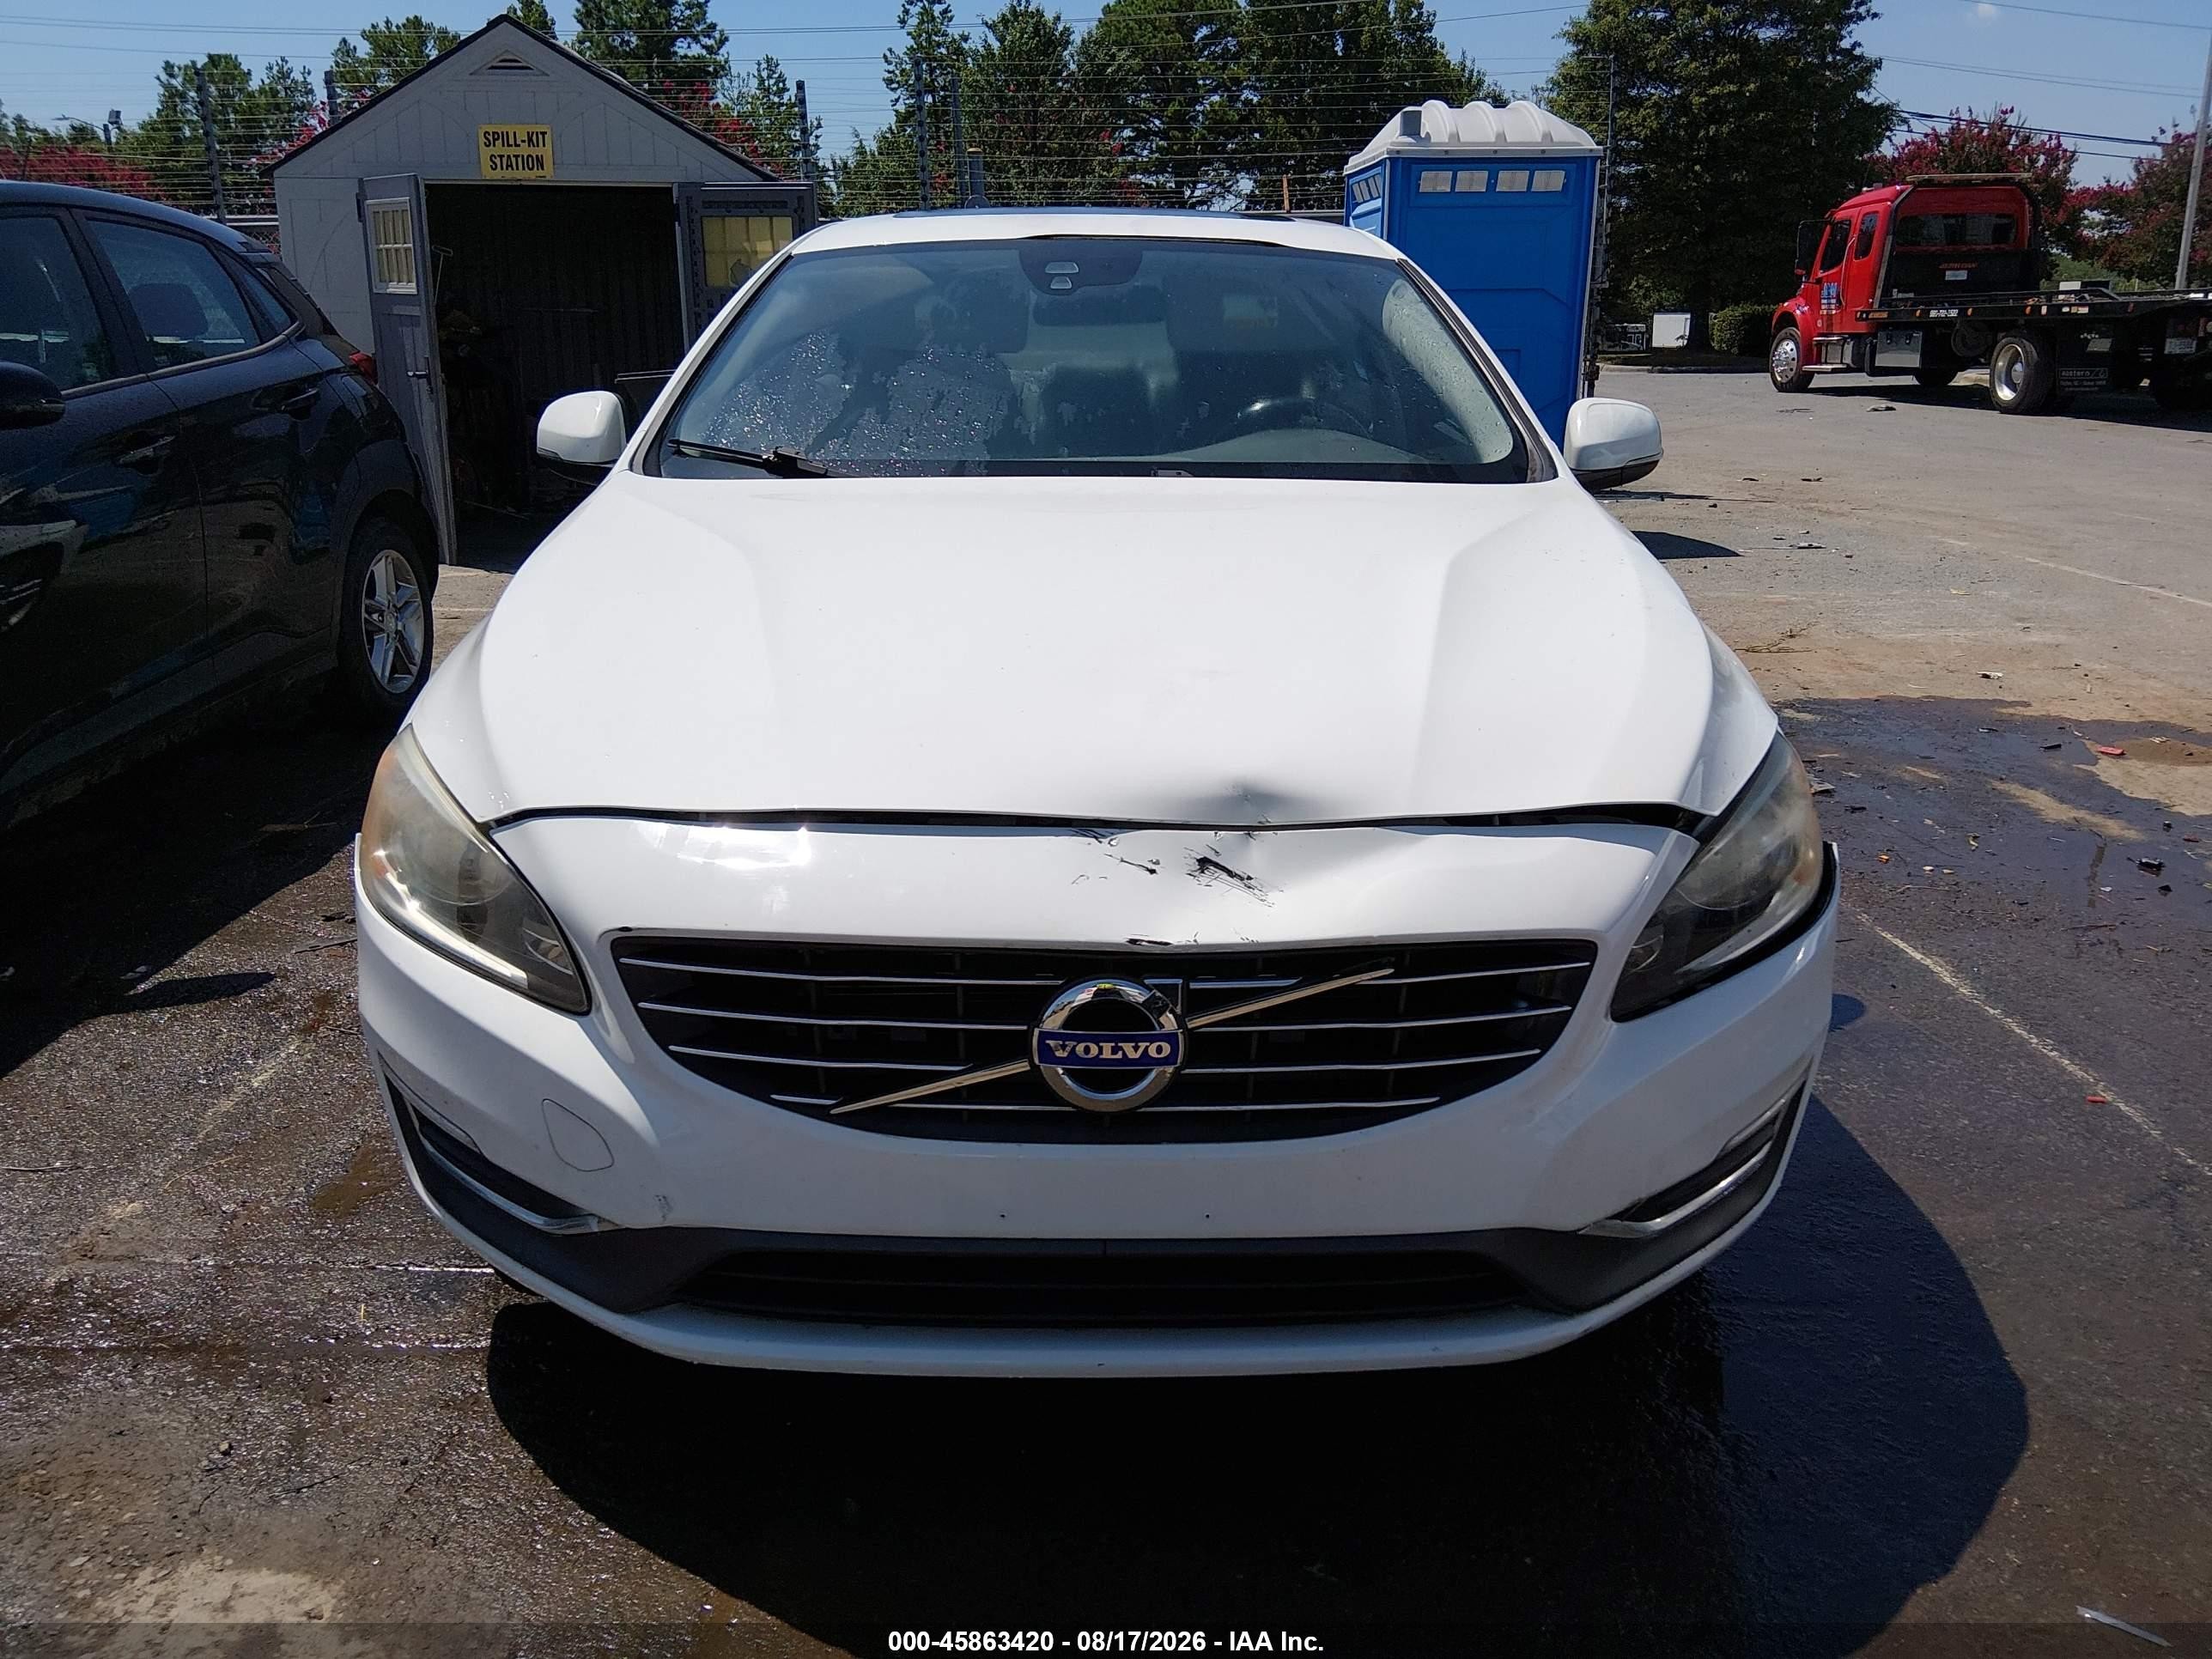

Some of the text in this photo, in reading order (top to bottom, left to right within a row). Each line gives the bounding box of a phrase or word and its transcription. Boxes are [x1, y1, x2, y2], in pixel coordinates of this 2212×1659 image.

[483, 131, 548, 148] SPILL-KIT
[489, 154, 544, 171] STATION
[1045, 1040, 1171, 1059] VOLVO
